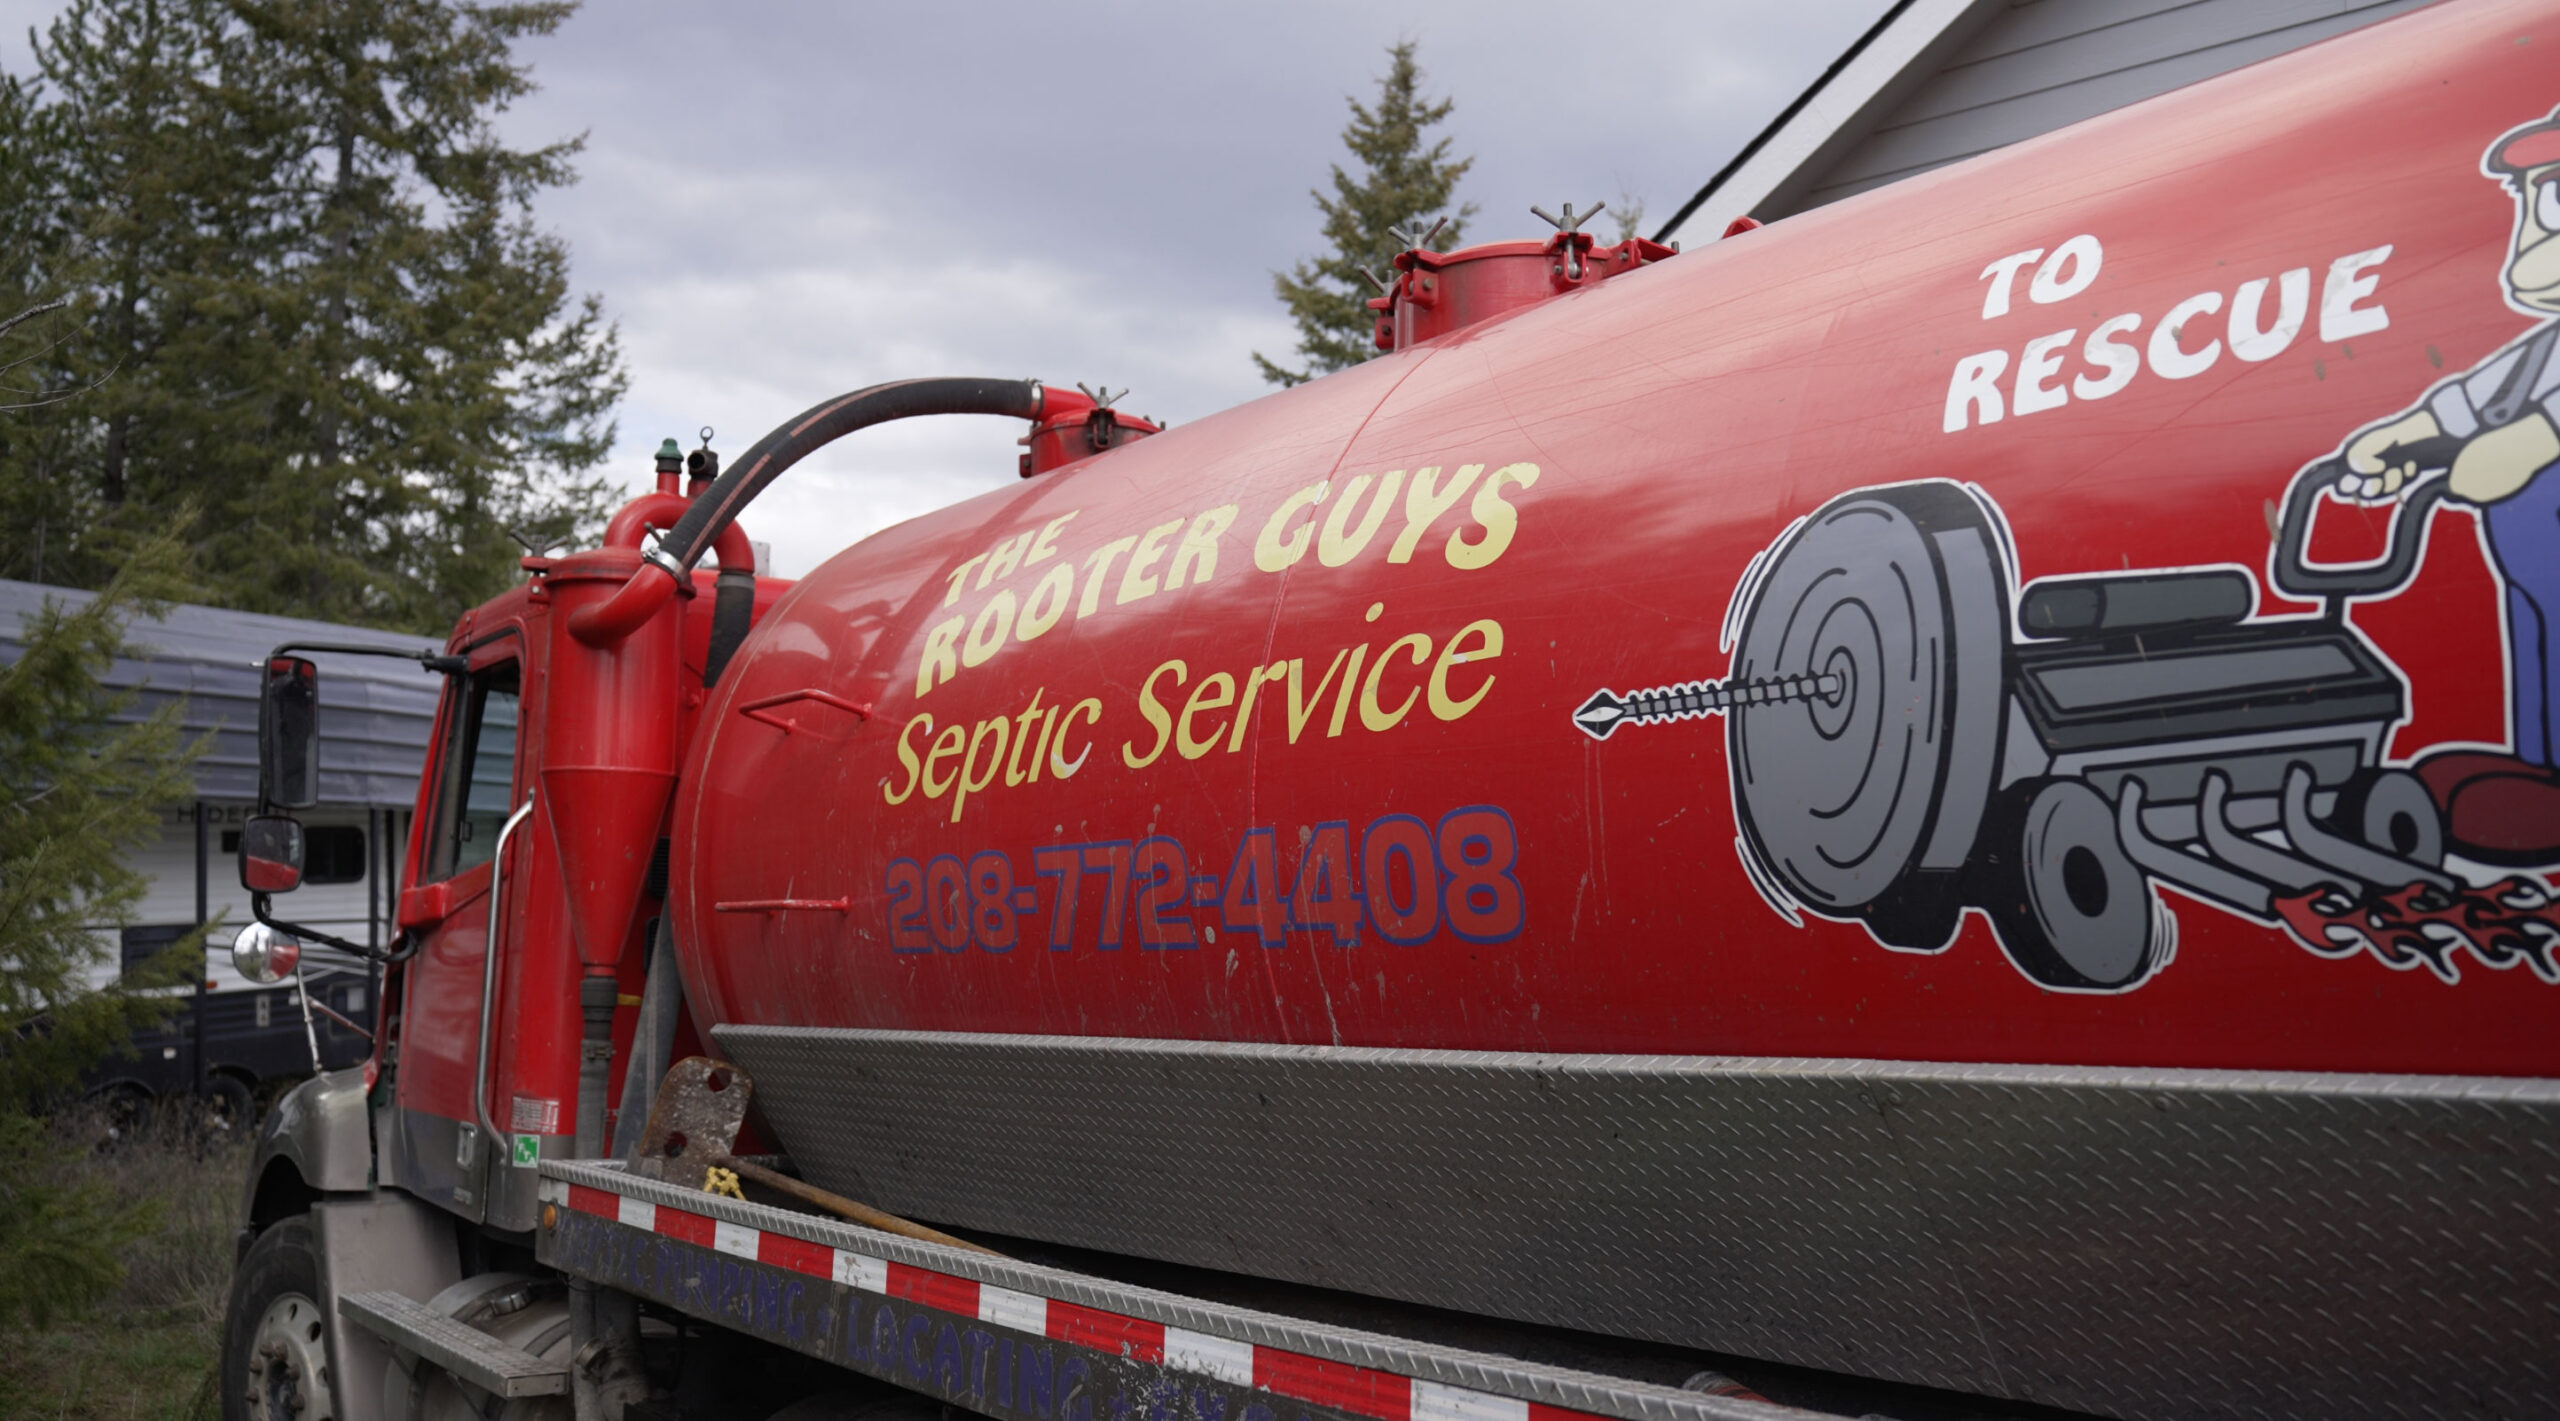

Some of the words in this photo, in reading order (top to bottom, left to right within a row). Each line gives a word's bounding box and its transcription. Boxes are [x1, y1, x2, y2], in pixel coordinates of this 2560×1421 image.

[1943, 244, 2394, 433] RESCUE
[1979, 234, 2103, 320] TO
[915, 503, 1239, 700] ROOTER
[1253, 461, 1541, 573] GUYS
[944, 509, 1079, 608] THE
[883, 686, 1102, 823] Septic
[1122, 601, 1504, 769] Service
[884, 804, 1525, 953] 208-772-4408
[655, 1243, 806, 1341] PUMPING
[846, 1296, 1093, 1421] LOCATING
